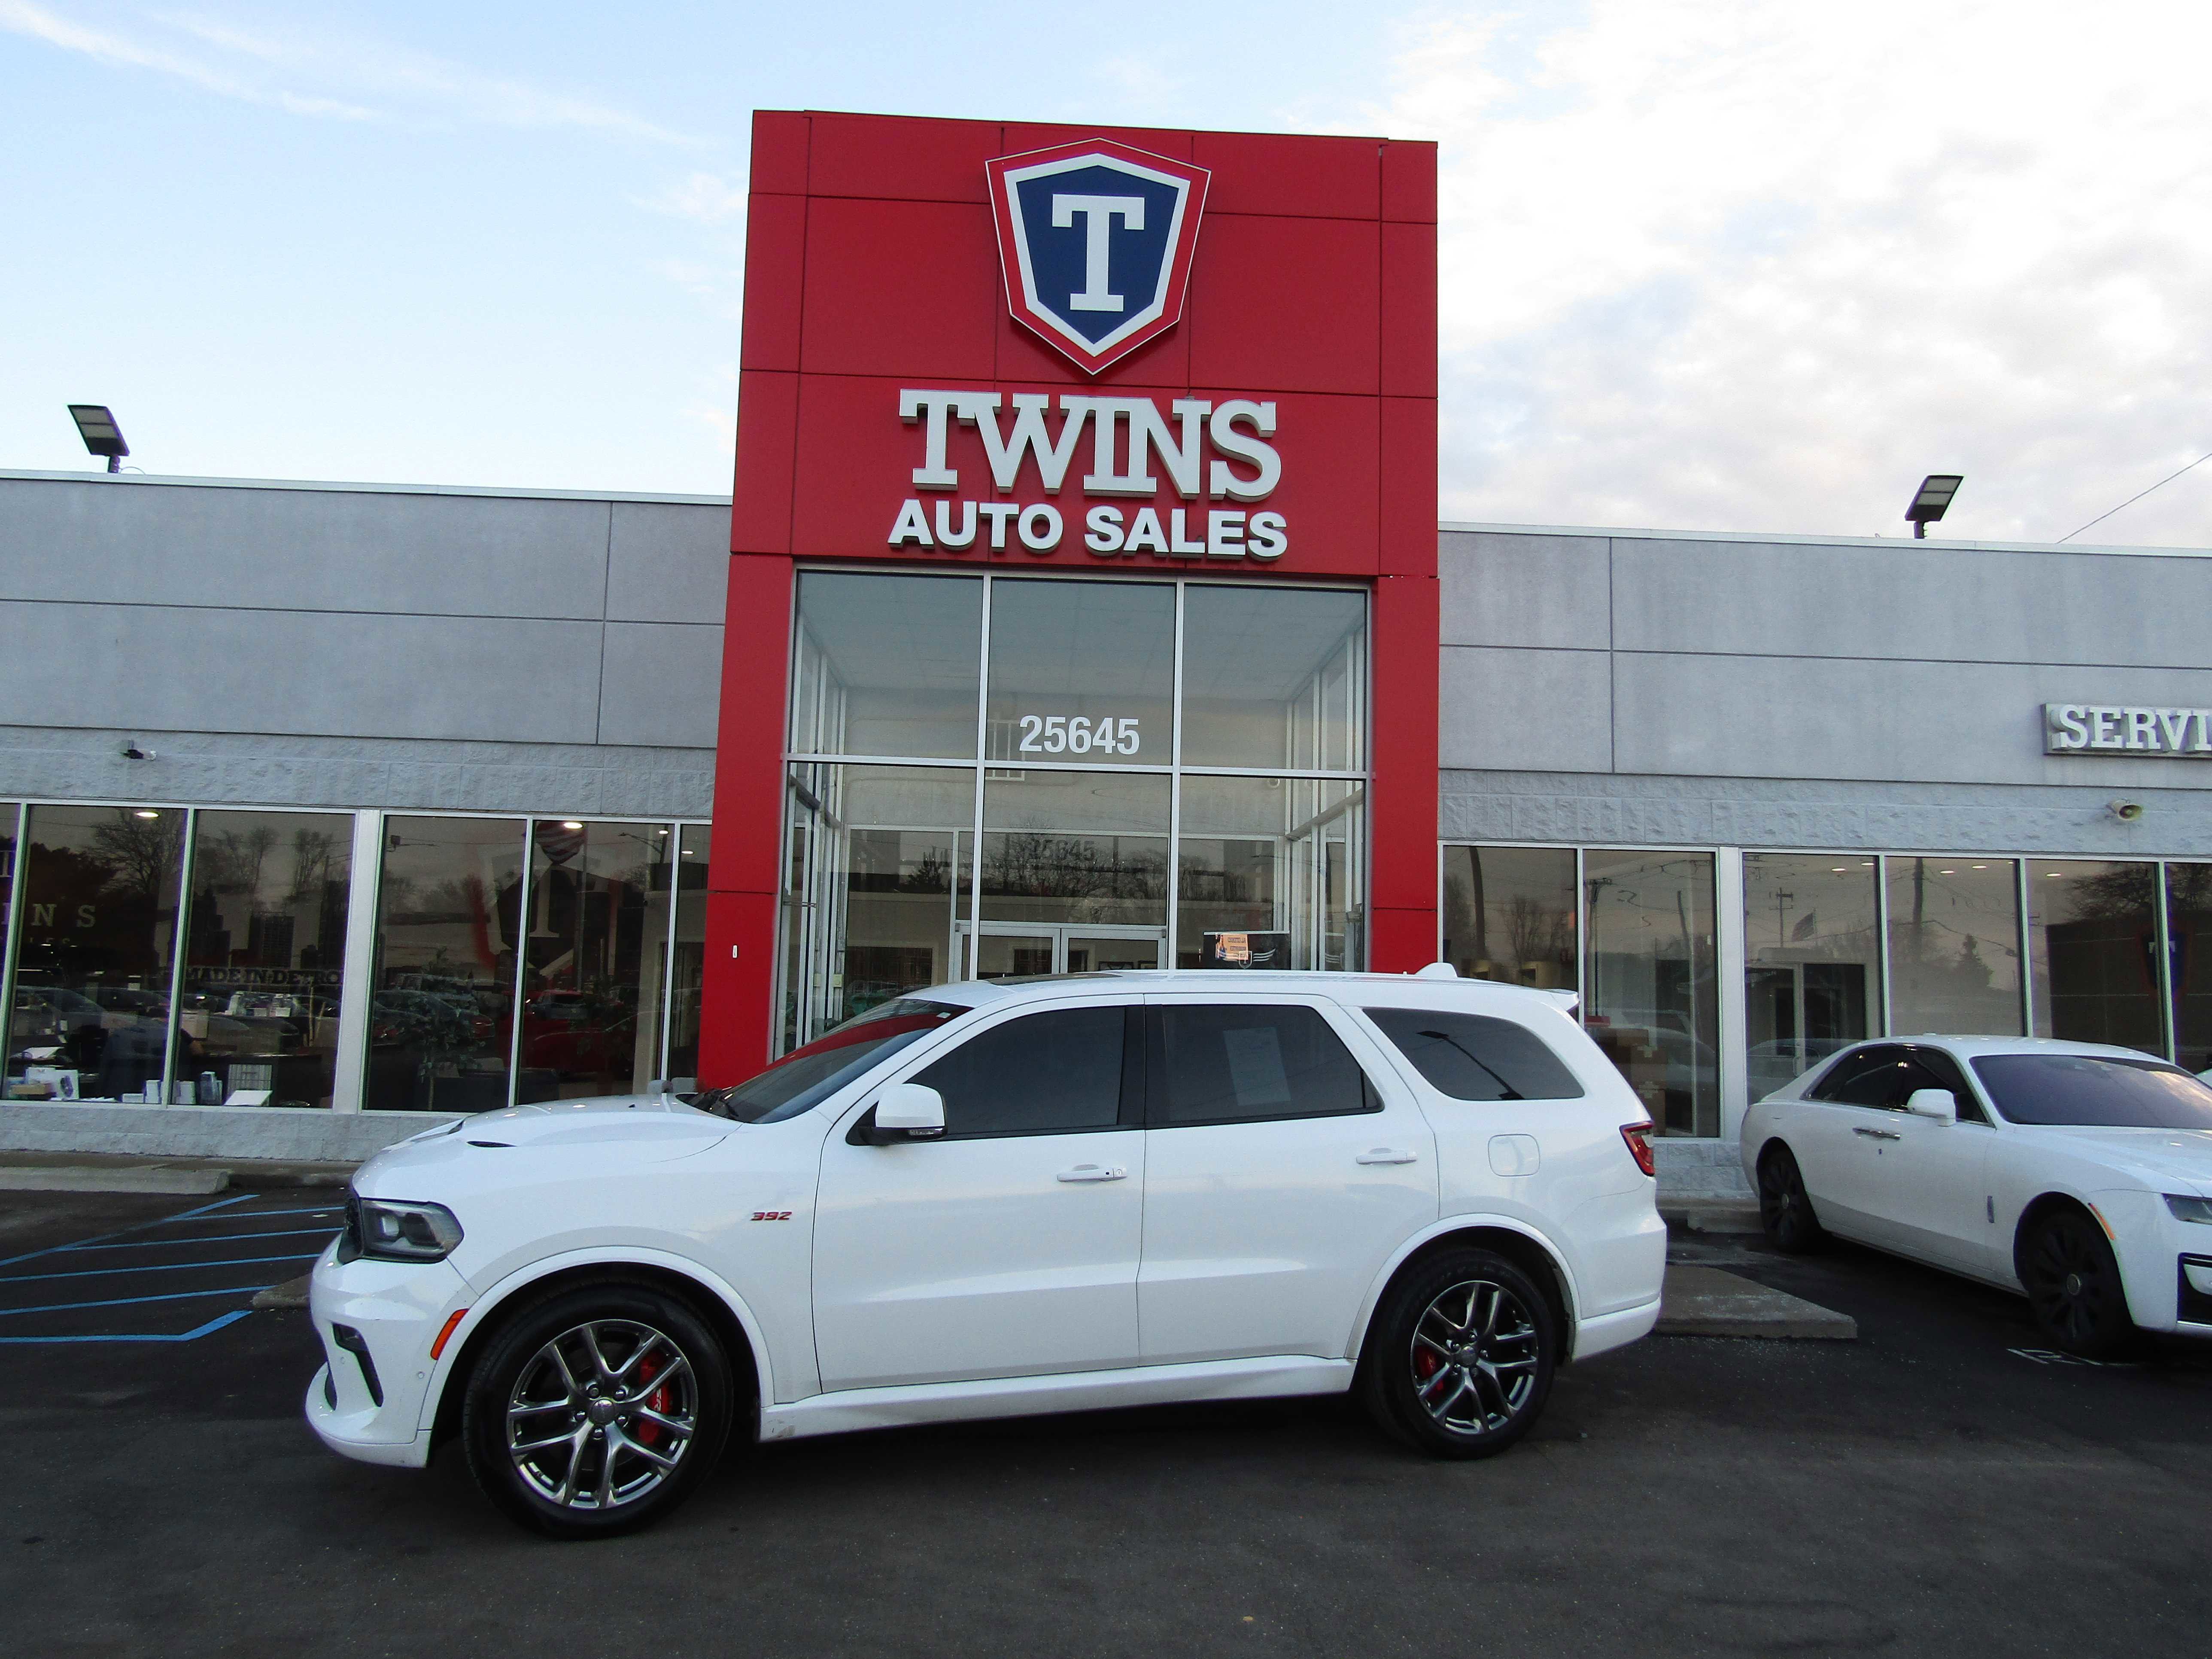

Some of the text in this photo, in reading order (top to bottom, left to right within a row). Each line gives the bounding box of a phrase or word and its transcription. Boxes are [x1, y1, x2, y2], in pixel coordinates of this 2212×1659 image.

[1051, 193, 1145, 312] T
[899, 388, 1282, 502] TWINS
[887, 498, 1288, 561] AUTO SALES
[1019, 715, 1140, 755] 25645
[2055, 704, 2212, 750] SERVI
[750, 1211, 793, 1221] 392
